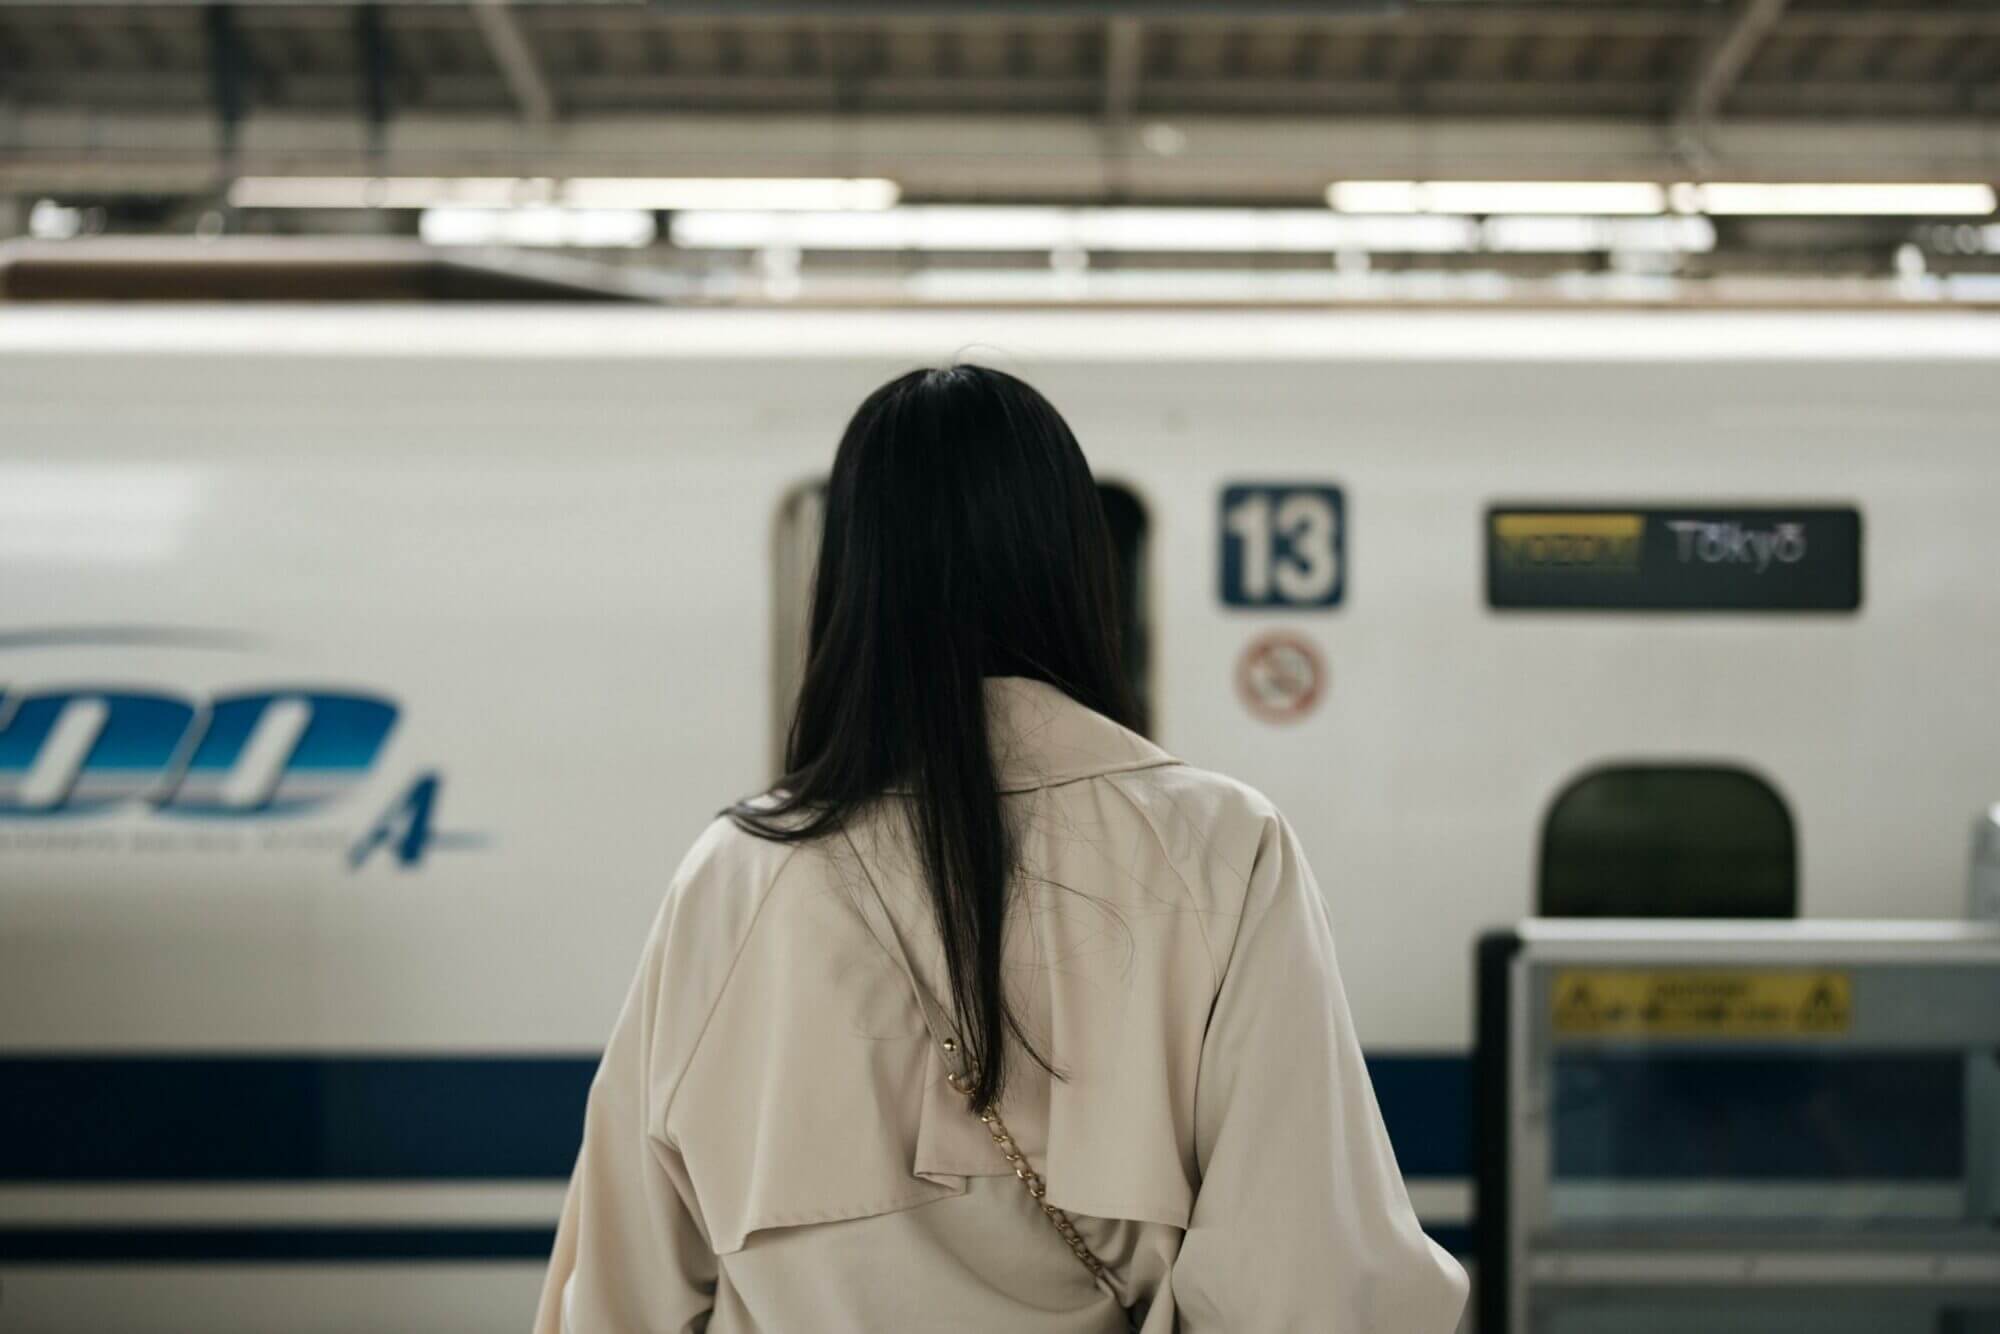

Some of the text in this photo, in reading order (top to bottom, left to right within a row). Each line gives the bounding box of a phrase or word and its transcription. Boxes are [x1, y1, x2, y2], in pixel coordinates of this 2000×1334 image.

[1228, 496, 1335, 599] 13
[0, 690, 402, 818] 00
[345, 768, 447, 868] A
